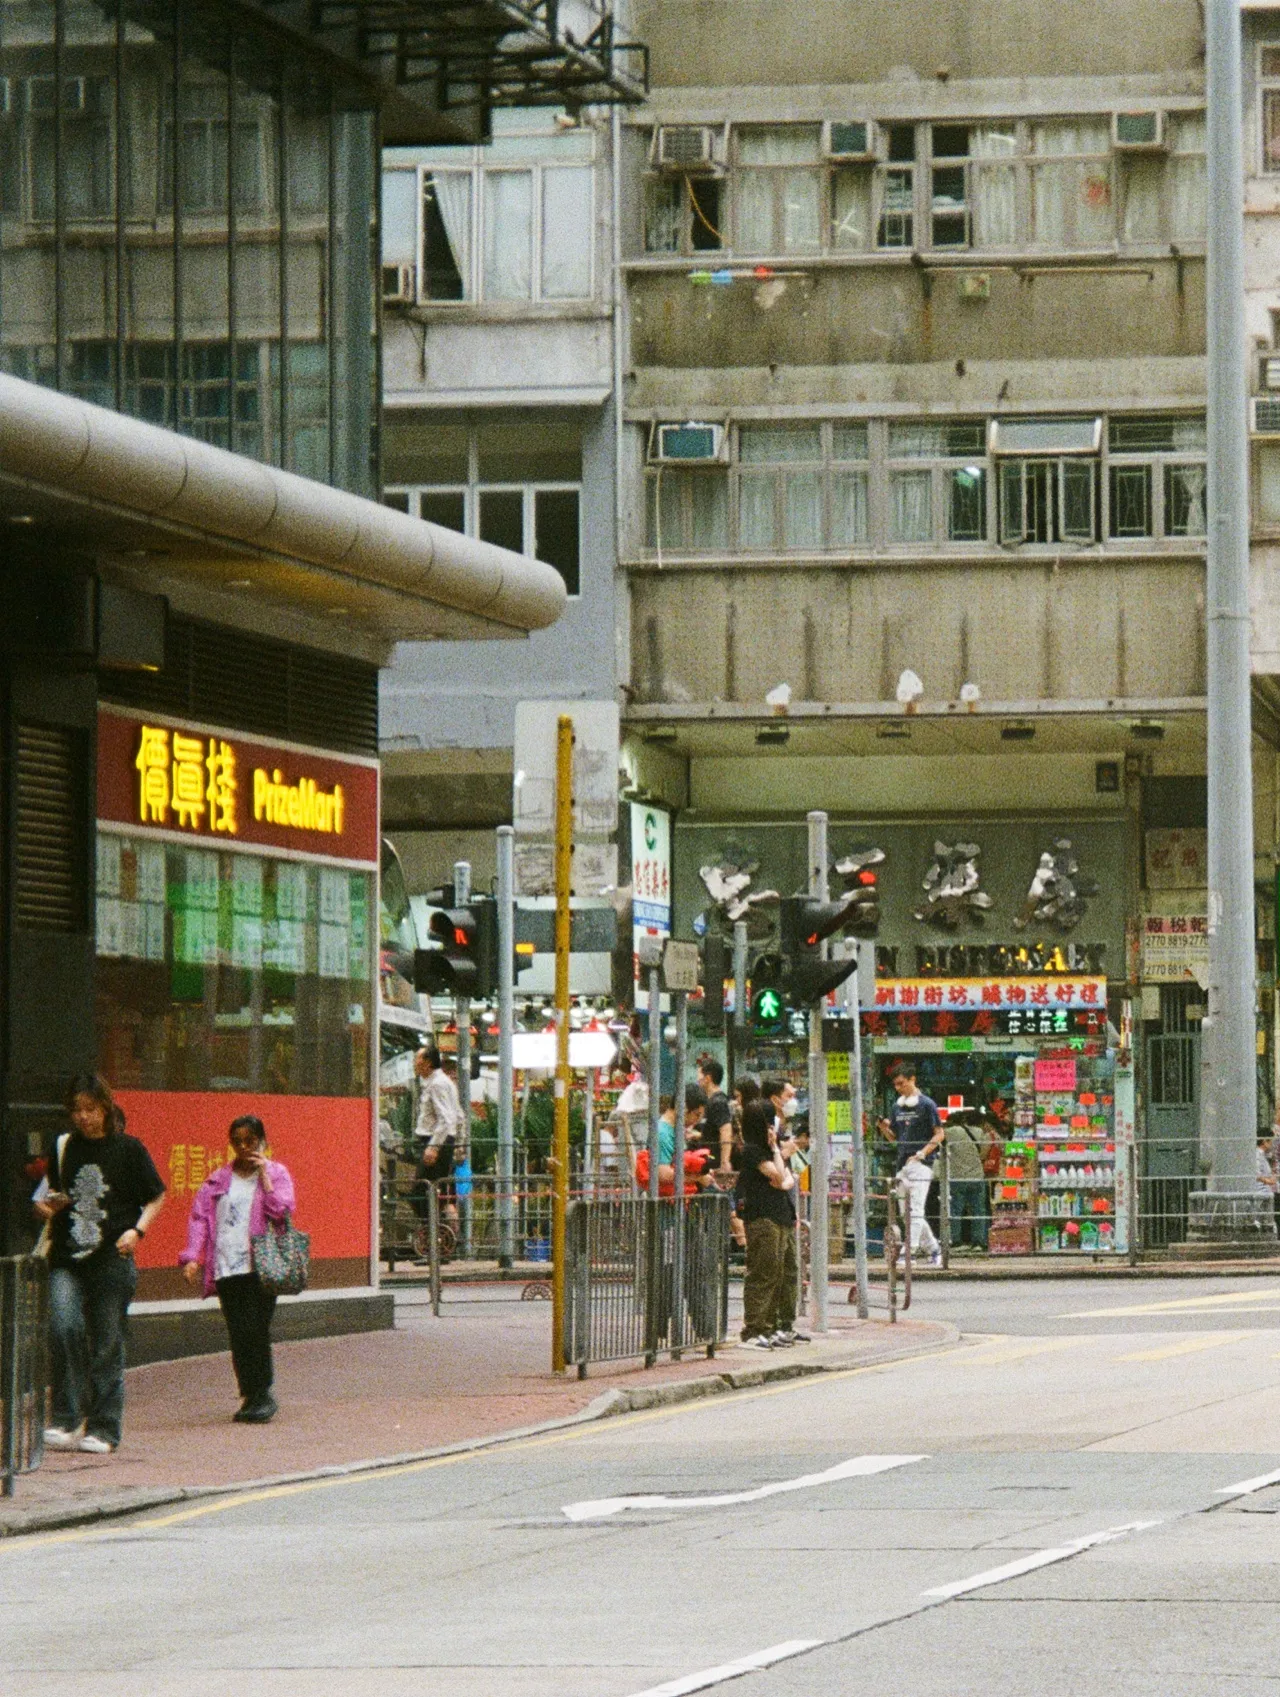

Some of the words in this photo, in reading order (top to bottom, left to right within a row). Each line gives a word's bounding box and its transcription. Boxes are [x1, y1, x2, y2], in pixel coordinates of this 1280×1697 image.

[253, 768, 344, 835] PrizeMart
[1146, 934, 1166, 947] 2770
[1146, 963, 1166, 976] 2770
